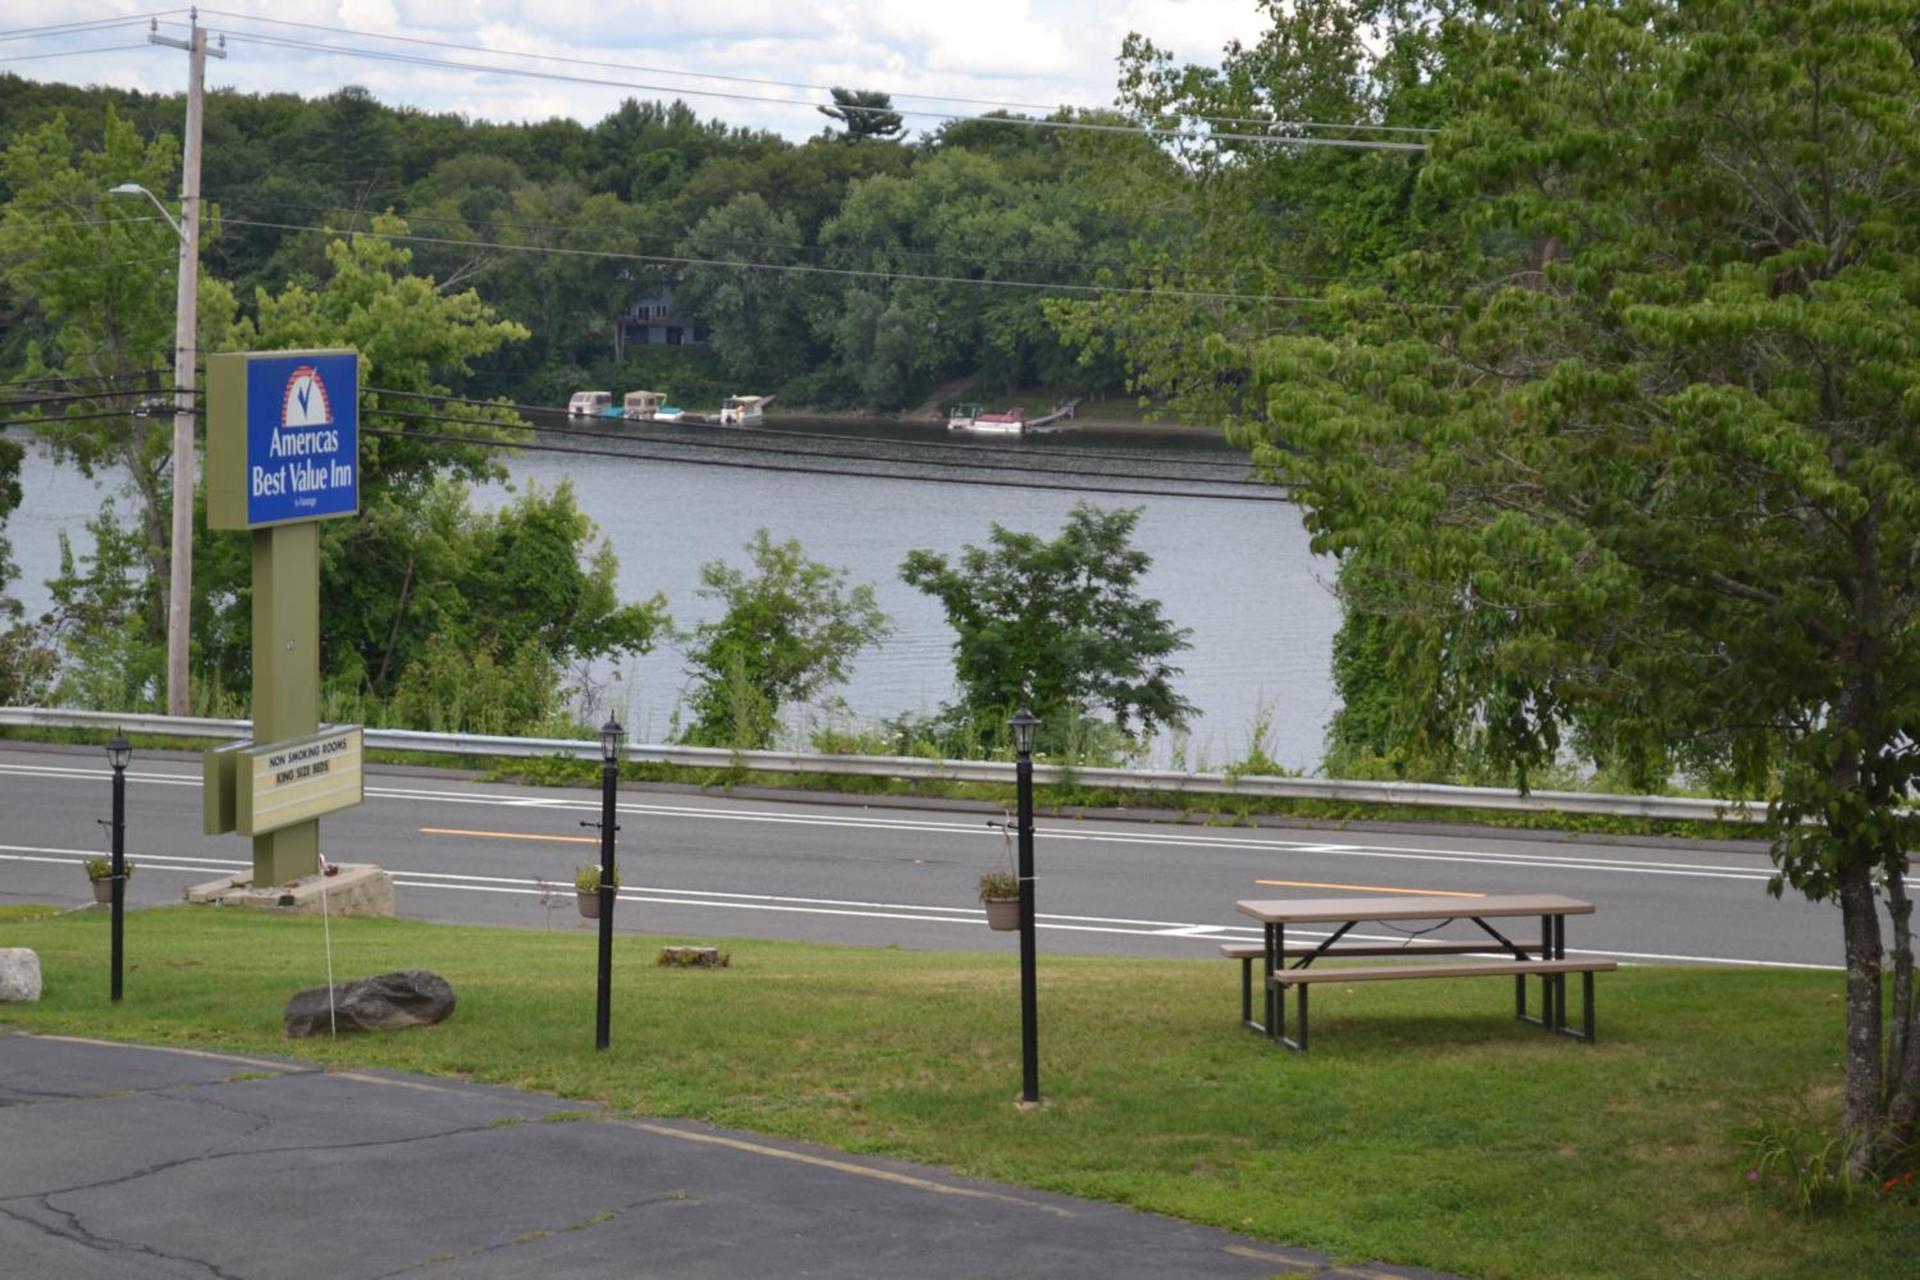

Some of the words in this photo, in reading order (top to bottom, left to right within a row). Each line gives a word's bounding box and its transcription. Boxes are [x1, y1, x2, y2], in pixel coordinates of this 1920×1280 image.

[269, 427, 338, 458] Americas
[253, 466, 286, 496] Best
[289, 458, 328, 492] Value
[331, 458, 351, 488] Inn
[269, 755, 286, 768] NON
[288, 745, 320, 763] SMOKING
[322, 738, 347, 754] ROOMS
[276, 770, 294, 784] KING
[297, 765, 310, 778] SIZE
[312, 760, 329, 774] BEDS
